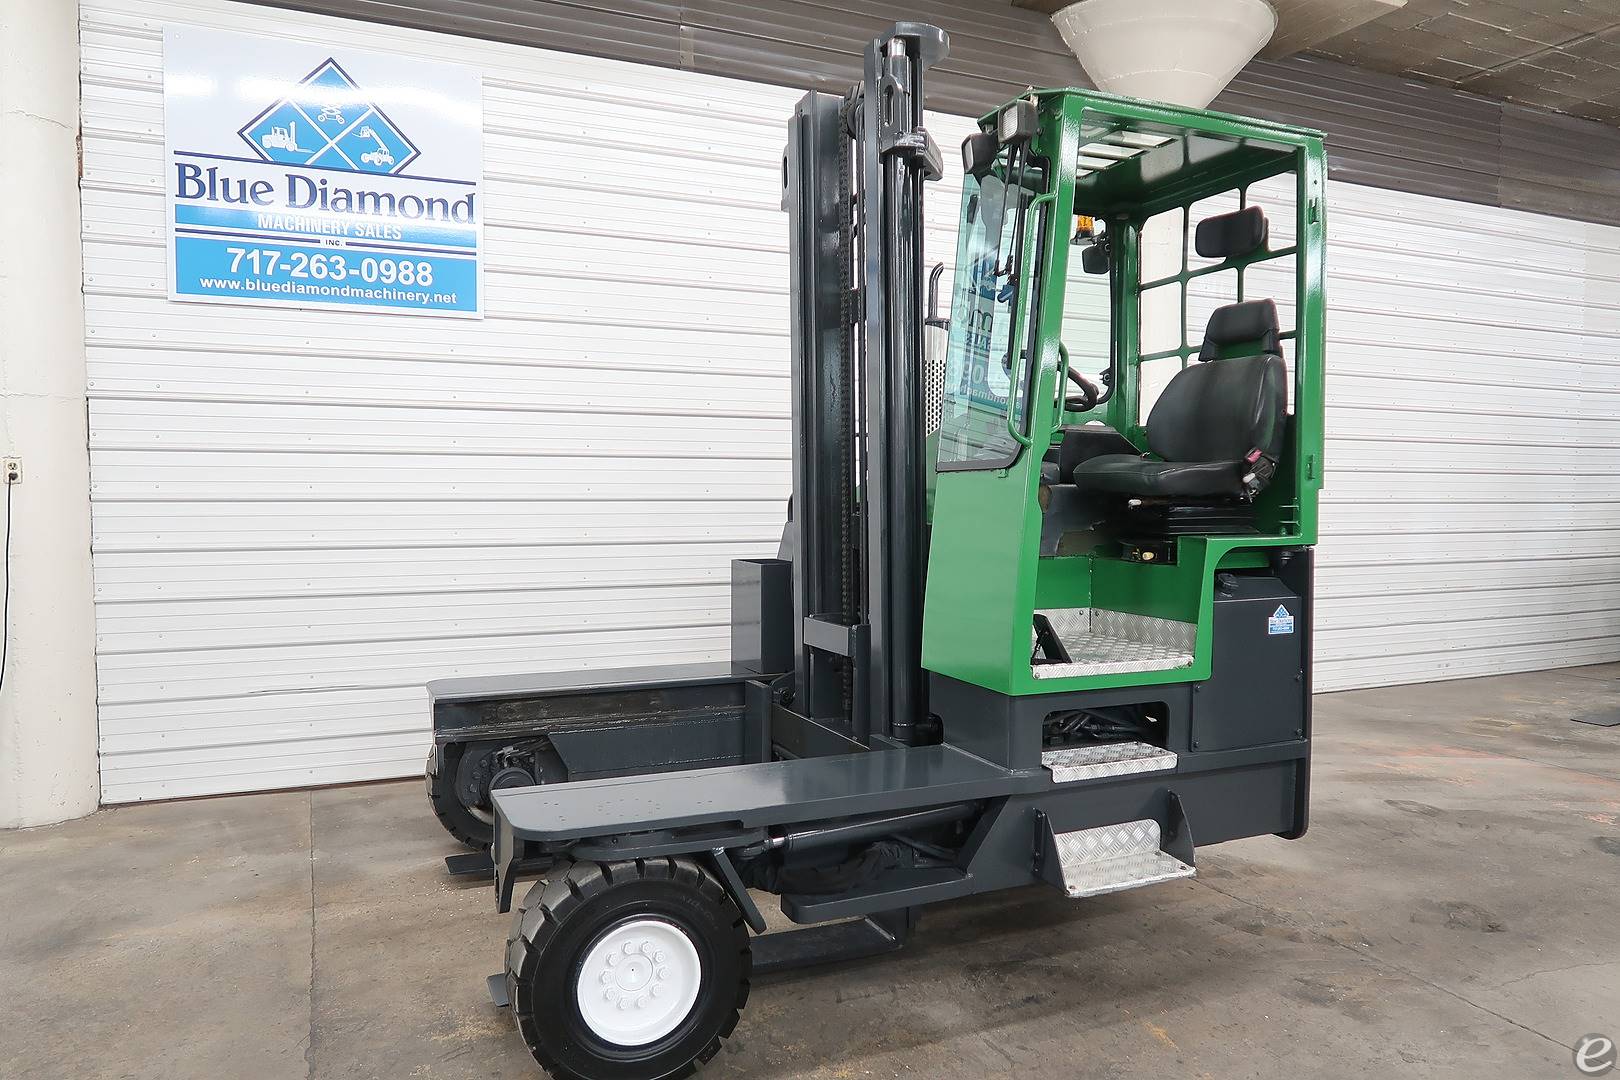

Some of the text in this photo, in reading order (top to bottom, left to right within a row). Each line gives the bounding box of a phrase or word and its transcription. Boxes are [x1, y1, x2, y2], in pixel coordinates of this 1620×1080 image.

[175, 162, 476, 225] Blue Diamond
[256, 212, 402, 240] MACHINERY SALES
[325, 239, 343, 247] INC.
[226, 247, 434, 287] 717-263-0988
[199, 277, 457, 305] www.bluediamondmachinery.net
